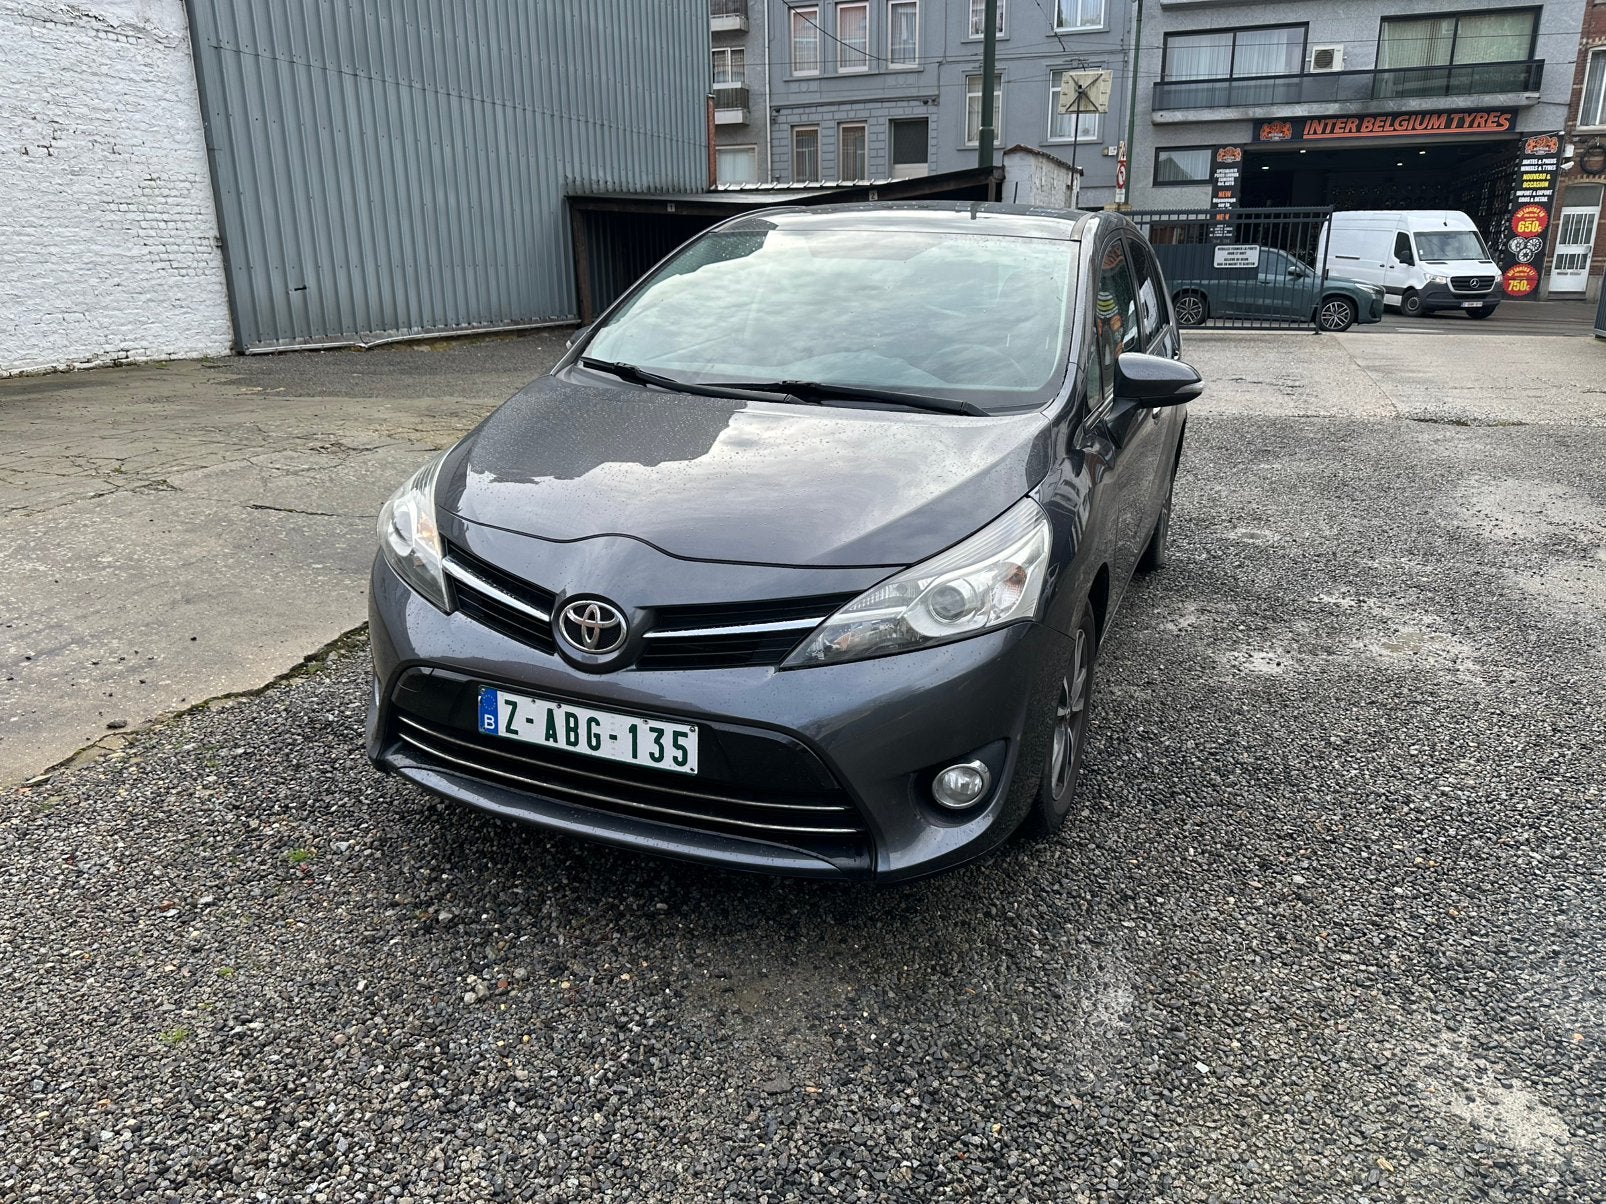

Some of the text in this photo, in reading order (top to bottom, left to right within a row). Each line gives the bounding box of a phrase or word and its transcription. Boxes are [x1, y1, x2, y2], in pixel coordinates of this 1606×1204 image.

[1303, 111, 1512, 135] INTER BELGIUM TYRES
[484, 714, 496, 730] B
[504, 699, 689, 767] Z-ABG-135
